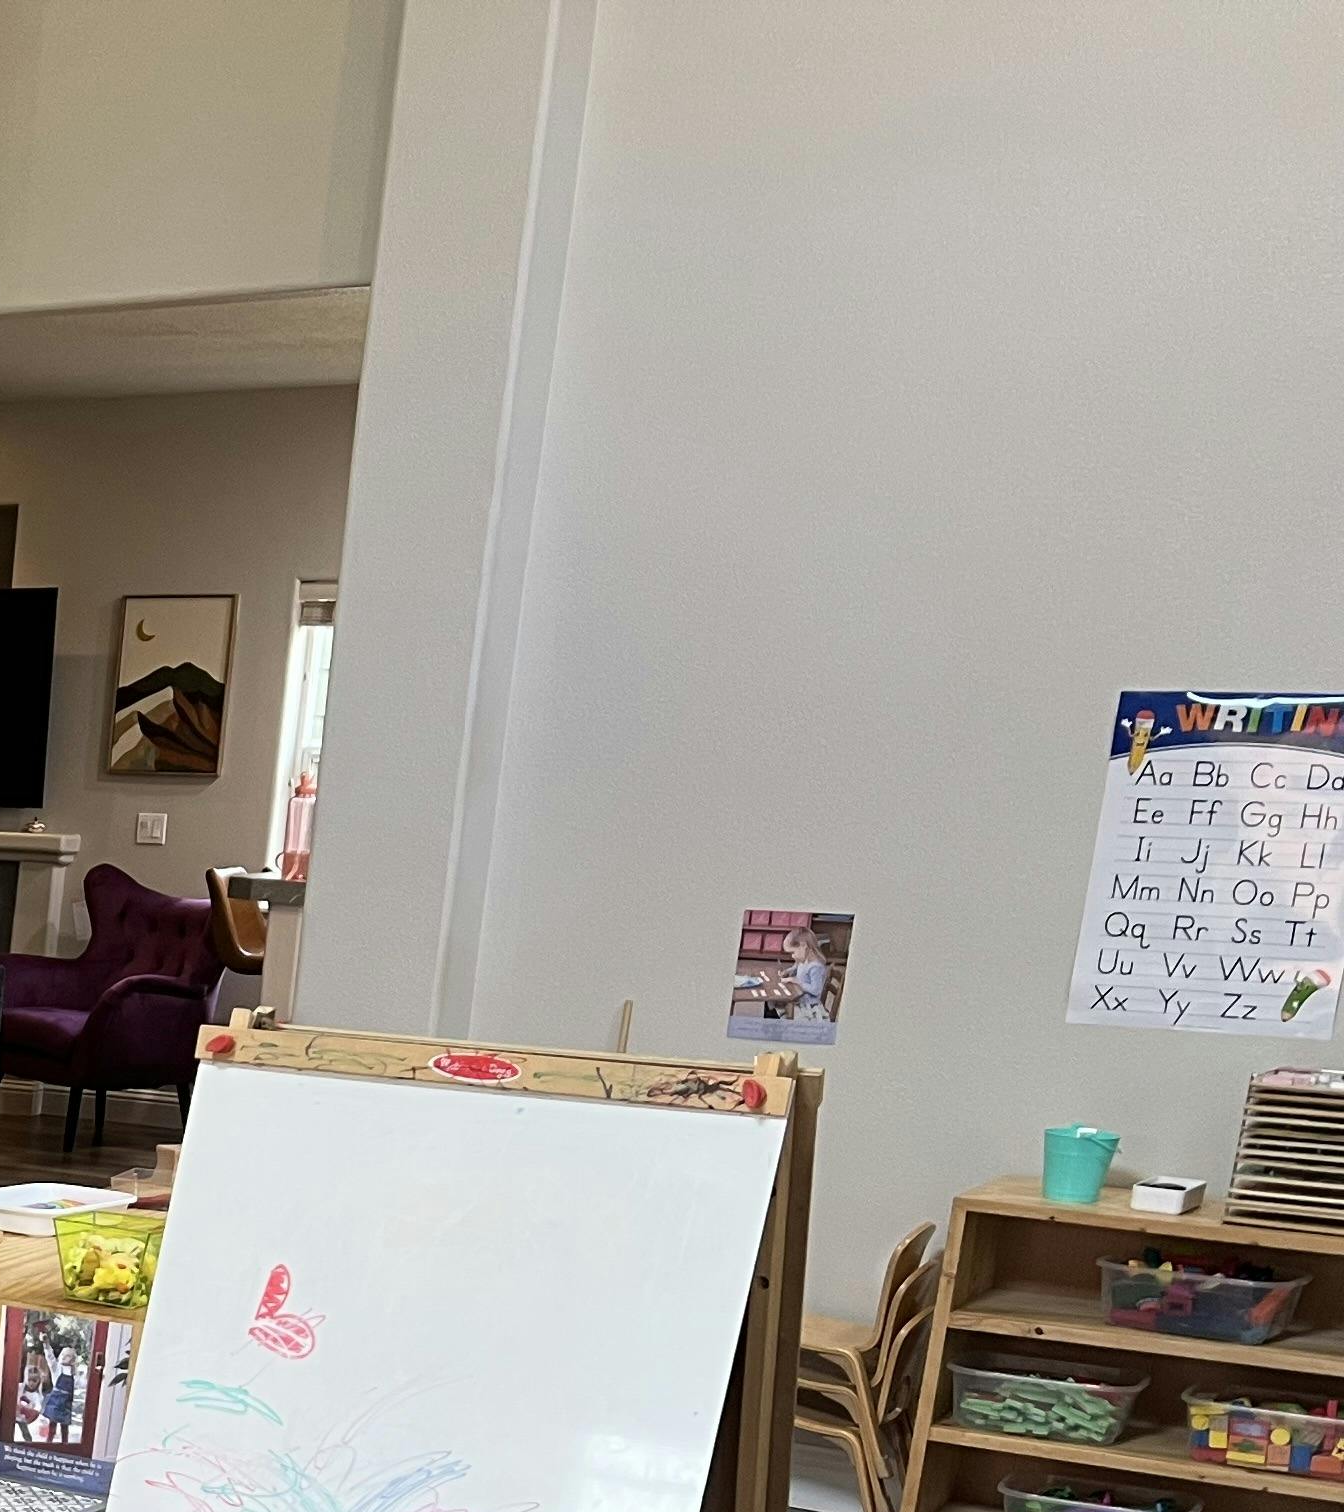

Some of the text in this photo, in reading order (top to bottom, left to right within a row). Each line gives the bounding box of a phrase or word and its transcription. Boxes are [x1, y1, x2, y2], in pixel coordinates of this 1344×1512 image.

[1176, 703, 1344, 736] WRITIN
[1134, 760, 1173, 787] Aa
[1192, 761, 1230, 788] Bb
[1251, 762, 1287, 789] Cc
[1132, 798, 1338, 837] Ee Ff Gg Hh
[1134, 836, 1152, 862] Ii
[1180, 838, 1211, 874] Jj
[1236, 840, 1272, 867] Kk
[1110, 874, 1330, 919] Mm Nn Oo Pp
[1104, 911, 1317, 949] Qq Rr Ss Tt
[1096, 949, 1285, 984] Uu Vv Ww
[1090, 985, 1258, 1026] Xx Yy Zz
